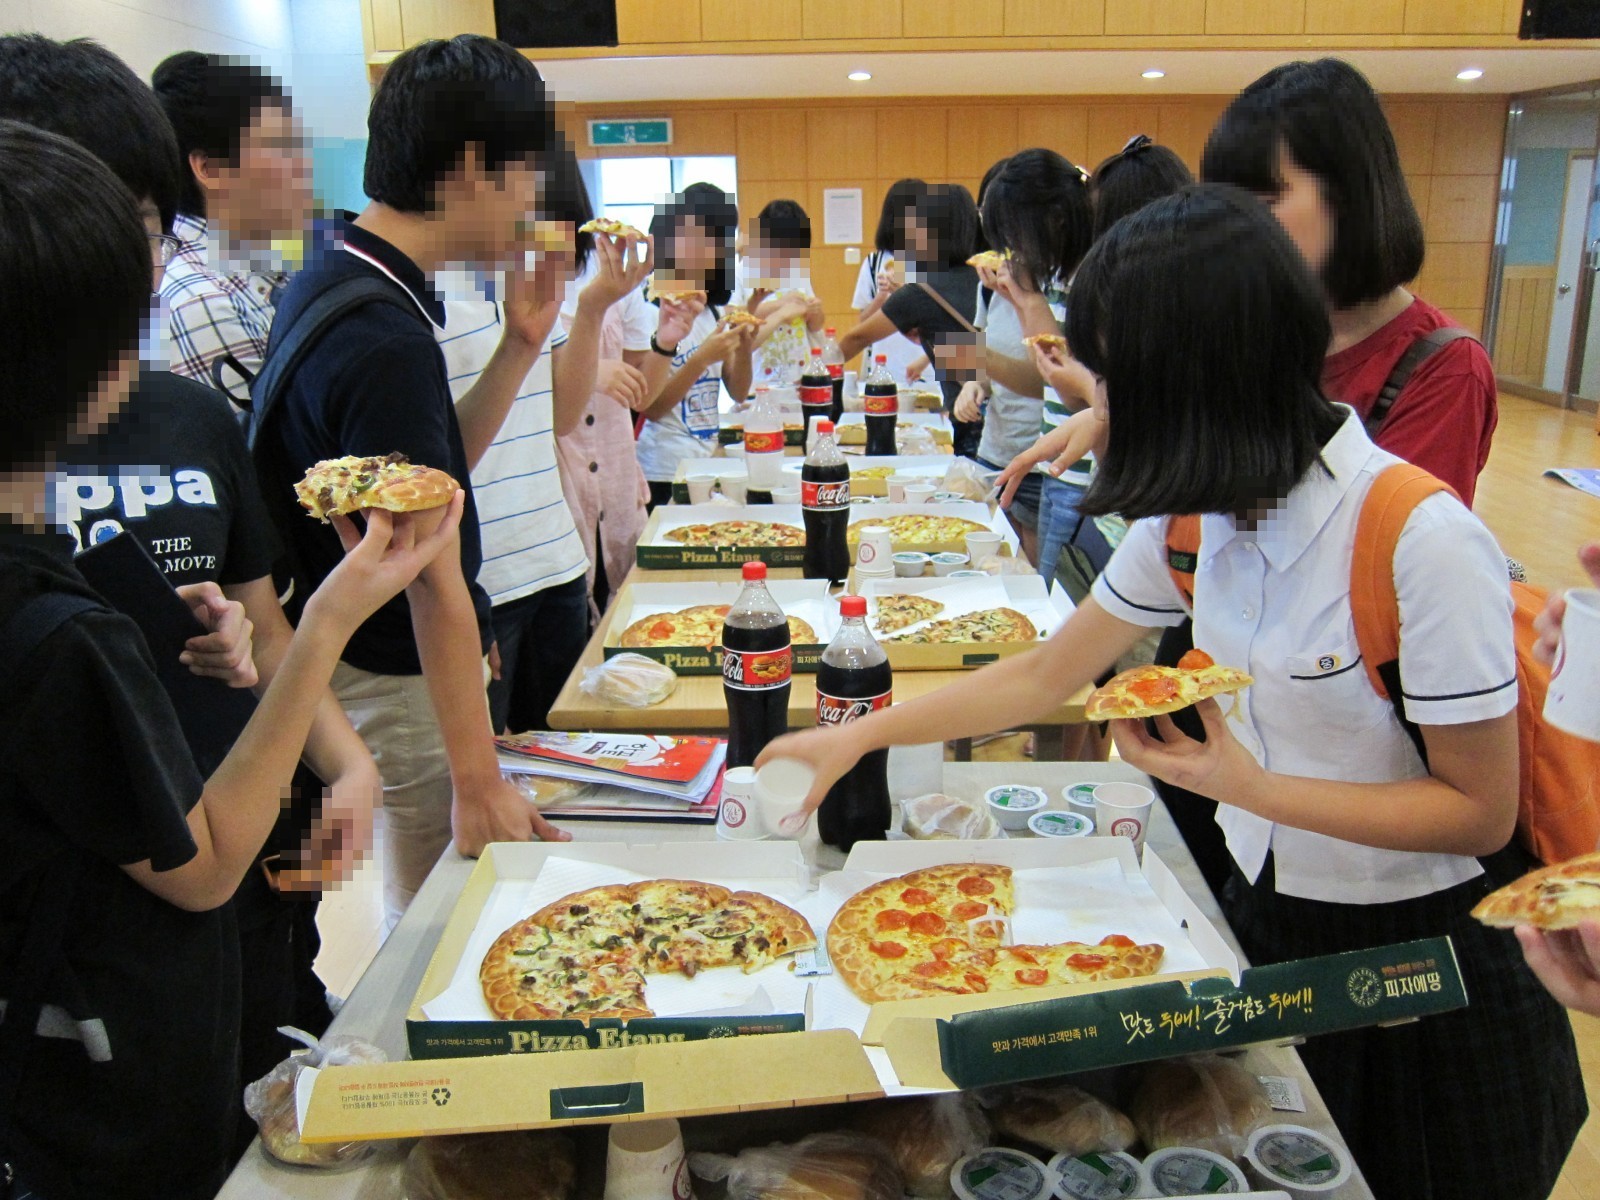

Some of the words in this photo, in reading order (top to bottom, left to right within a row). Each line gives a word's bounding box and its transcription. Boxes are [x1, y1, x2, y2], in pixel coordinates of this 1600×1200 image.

[152, 536, 192, 555] THE
[164, 555, 216, 573] MOVE
[681, 551, 719, 563] Pizza
[721, 551, 762, 563] Etang
[664, 653, 711, 668] Pizza
[1384, 972, 1441, 997] 피자에땅
[1119, 1011, 1156, 1045] 맛도
[1159, 1004, 1200, 1040] 두배!
[1204, 997, 1266, 1036] 즐거움도
[1268, 987, 1312, 1020] 두배!!
[508, 1030, 591, 1053] Pizza
[992, 1040, 1010, 1054] 맛과
[1012, 1034, 1047, 1050] 가격에서
[1048, 1028, 1082, 1045] 고객만족
[1083, 1025, 1098, 1039] 1위
